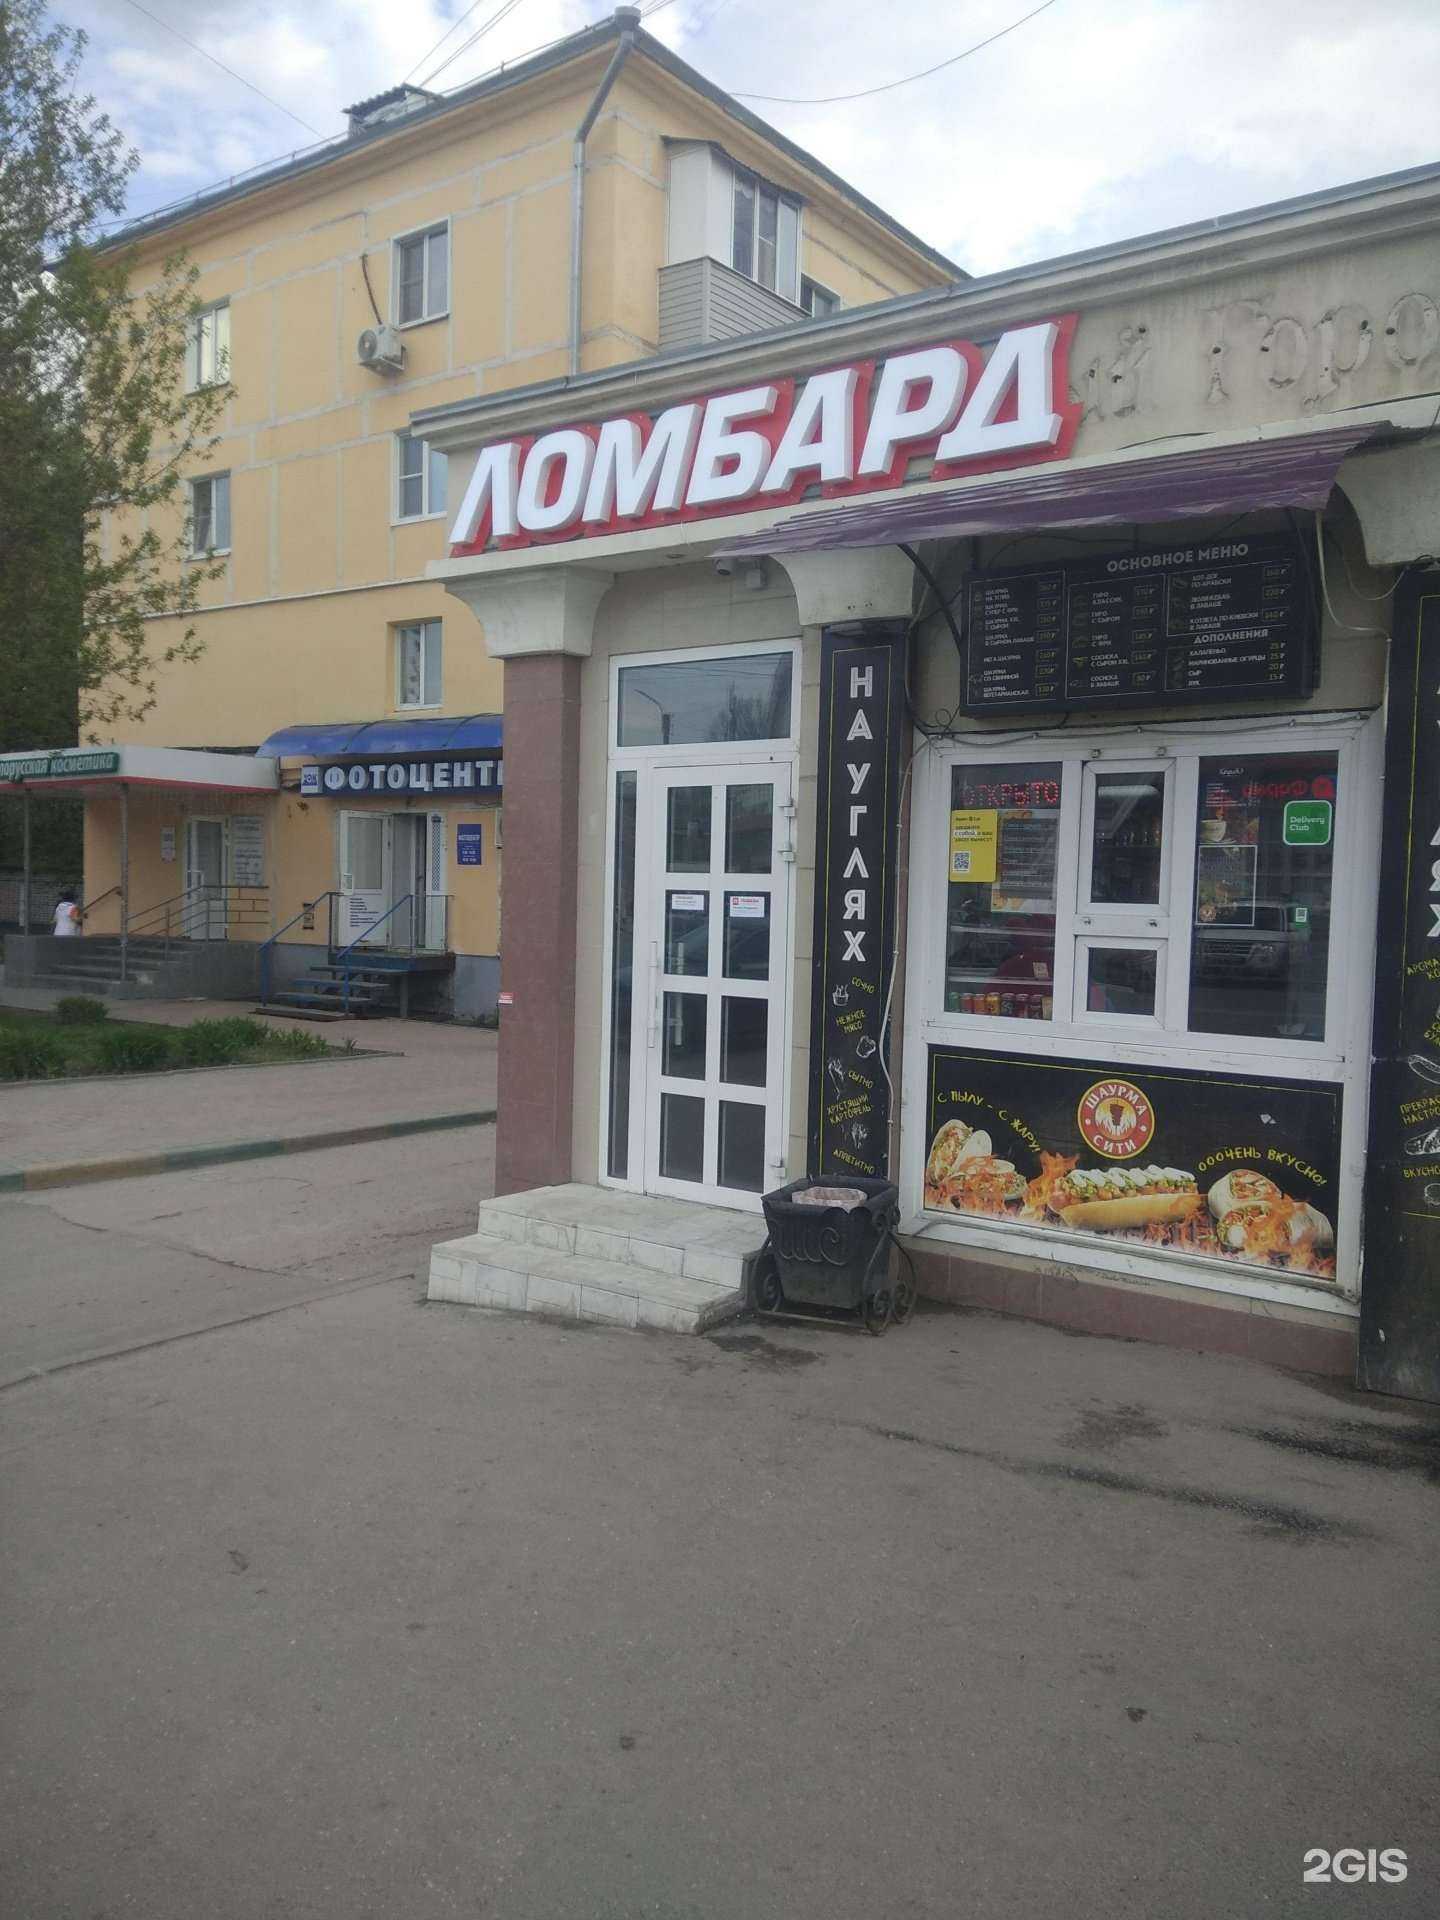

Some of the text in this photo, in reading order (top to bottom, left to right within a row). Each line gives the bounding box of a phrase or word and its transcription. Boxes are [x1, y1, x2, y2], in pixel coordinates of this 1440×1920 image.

[448, 321, 1063, 548] ЛОМБАРД
[1106, 543, 1249, 572] ОСНОВНОЕ МЕНЮ
[1194, 629, 1269, 644] ДОПОЛНЕНИЯ
[1290, 816, 1325, 825] Delivery
[937, 1092, 948, 1103] С
[950, 1090, 985, 1106] ПЫЛУ
[998, 1110, 1008, 1120] С
[1085, 1084, 1148, 1116] ШАУРМА
[1093, 1134, 1137, 1154] СИТИ
[1198, 1146, 1328, 1186] ОООЧЕНЬ ВКУСНО!
